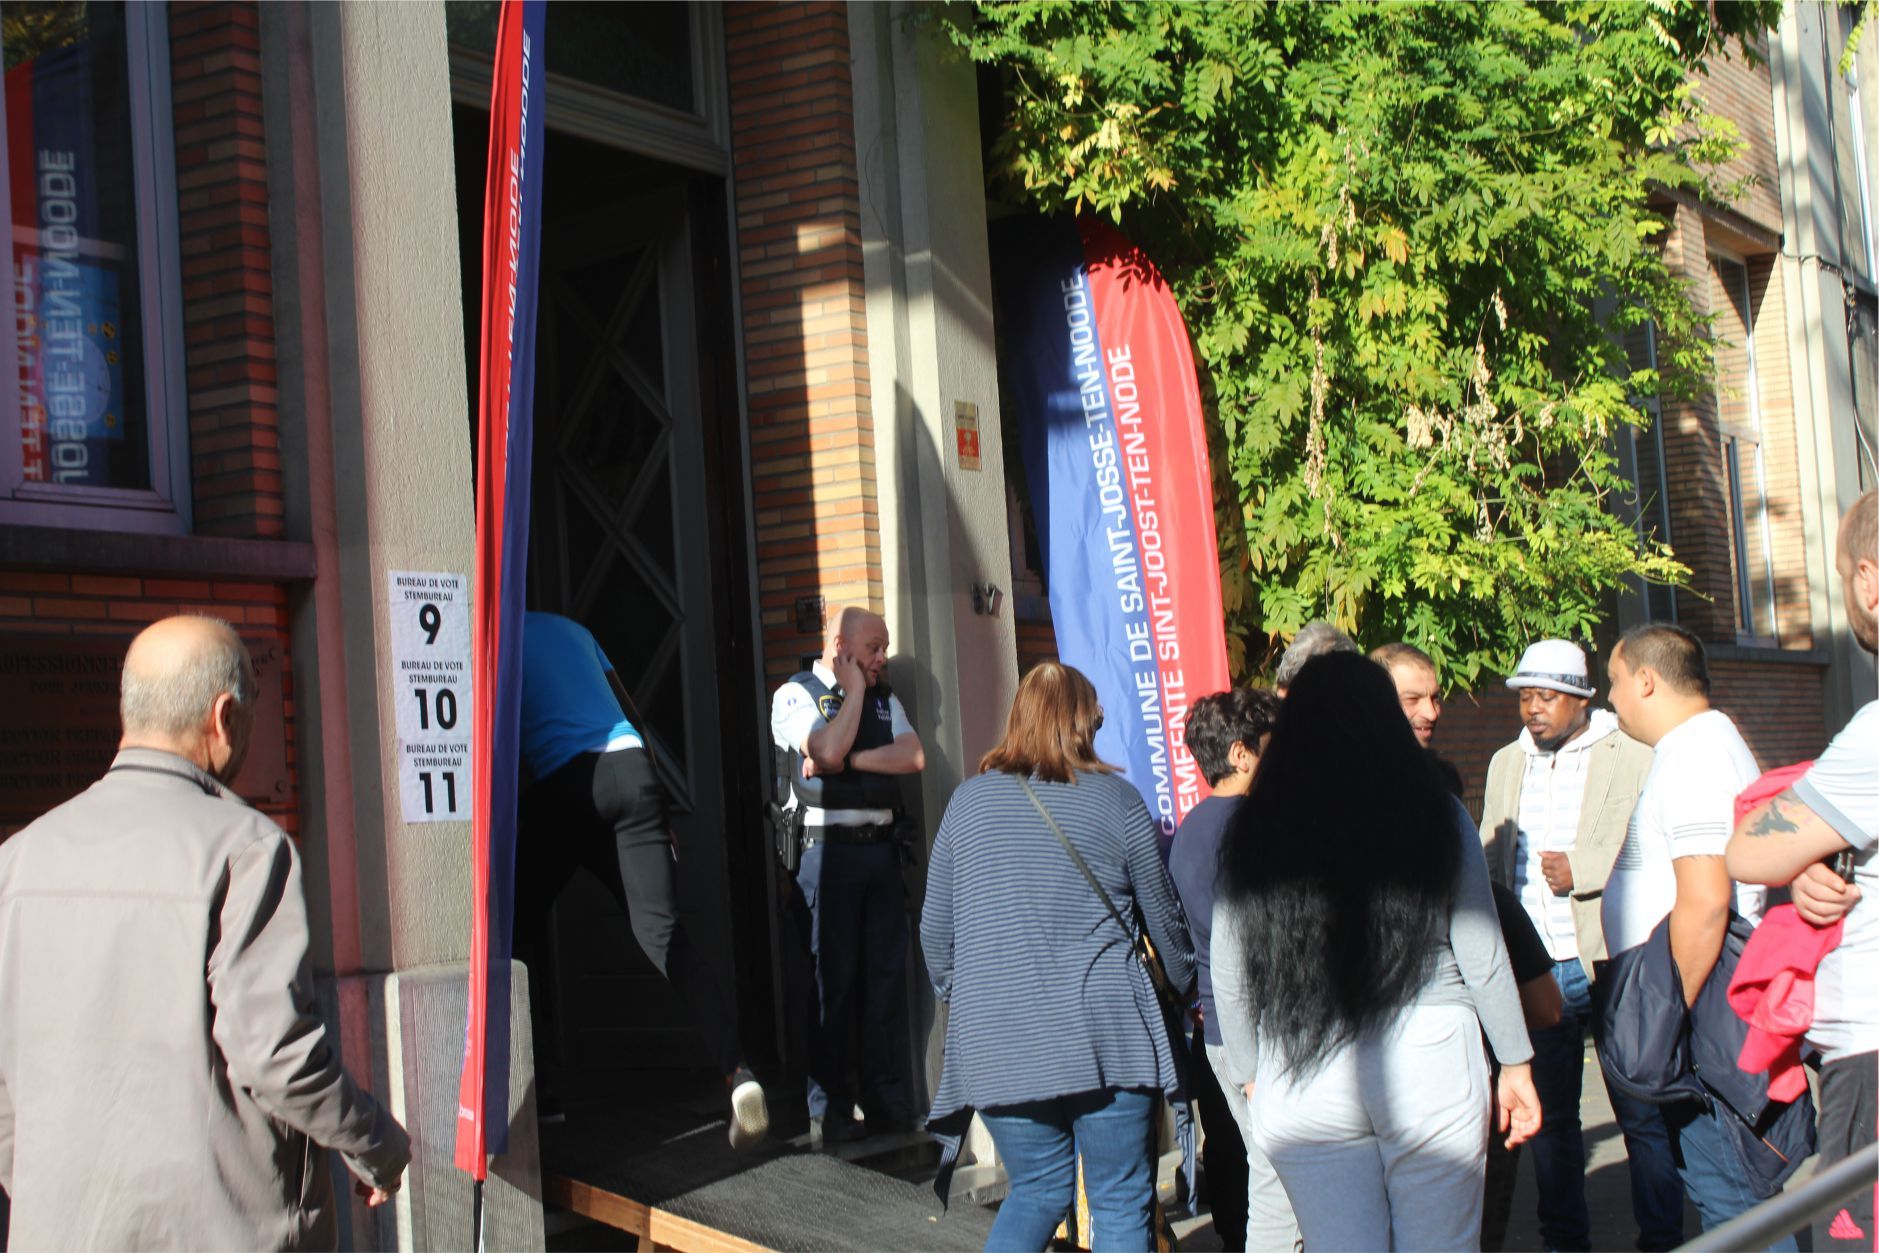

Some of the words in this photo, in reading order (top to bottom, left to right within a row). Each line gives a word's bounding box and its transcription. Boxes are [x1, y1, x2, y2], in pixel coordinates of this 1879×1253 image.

[1061, 273, 1143, 613] SAINT-JOSSE-TEN-NOODE
[1108, 343, 1180, 661] SINT-JOOST-TEN-NODE
[397, 577, 426, 587] BUREAU
[429, 579, 438, 588] DE
[440, 579, 459, 589] VOTE
[404, 591, 453, 602] STEMBUREAU
[419, 603, 441, 645] 9
[1126, 621, 1152, 662] DE
[401, 660, 431, 670] BUREAU
[433, 661, 443, 670] DE
[445, 661, 463, 670] VOTE
[409, 674, 458, 683] STEMBUREAU
[414, 688, 457, 730] 10
[406, 743, 436, 753] BUREAU
[438, 743, 447, 753] DE
[449, 743, 468, 753] VOTE
[413, 758, 462, 767] STEMBUREAU
[1135, 671, 1175, 835] COMMUNE
[1162, 669, 1199, 820] EMEENTE
[419, 772, 456, 813] 11
